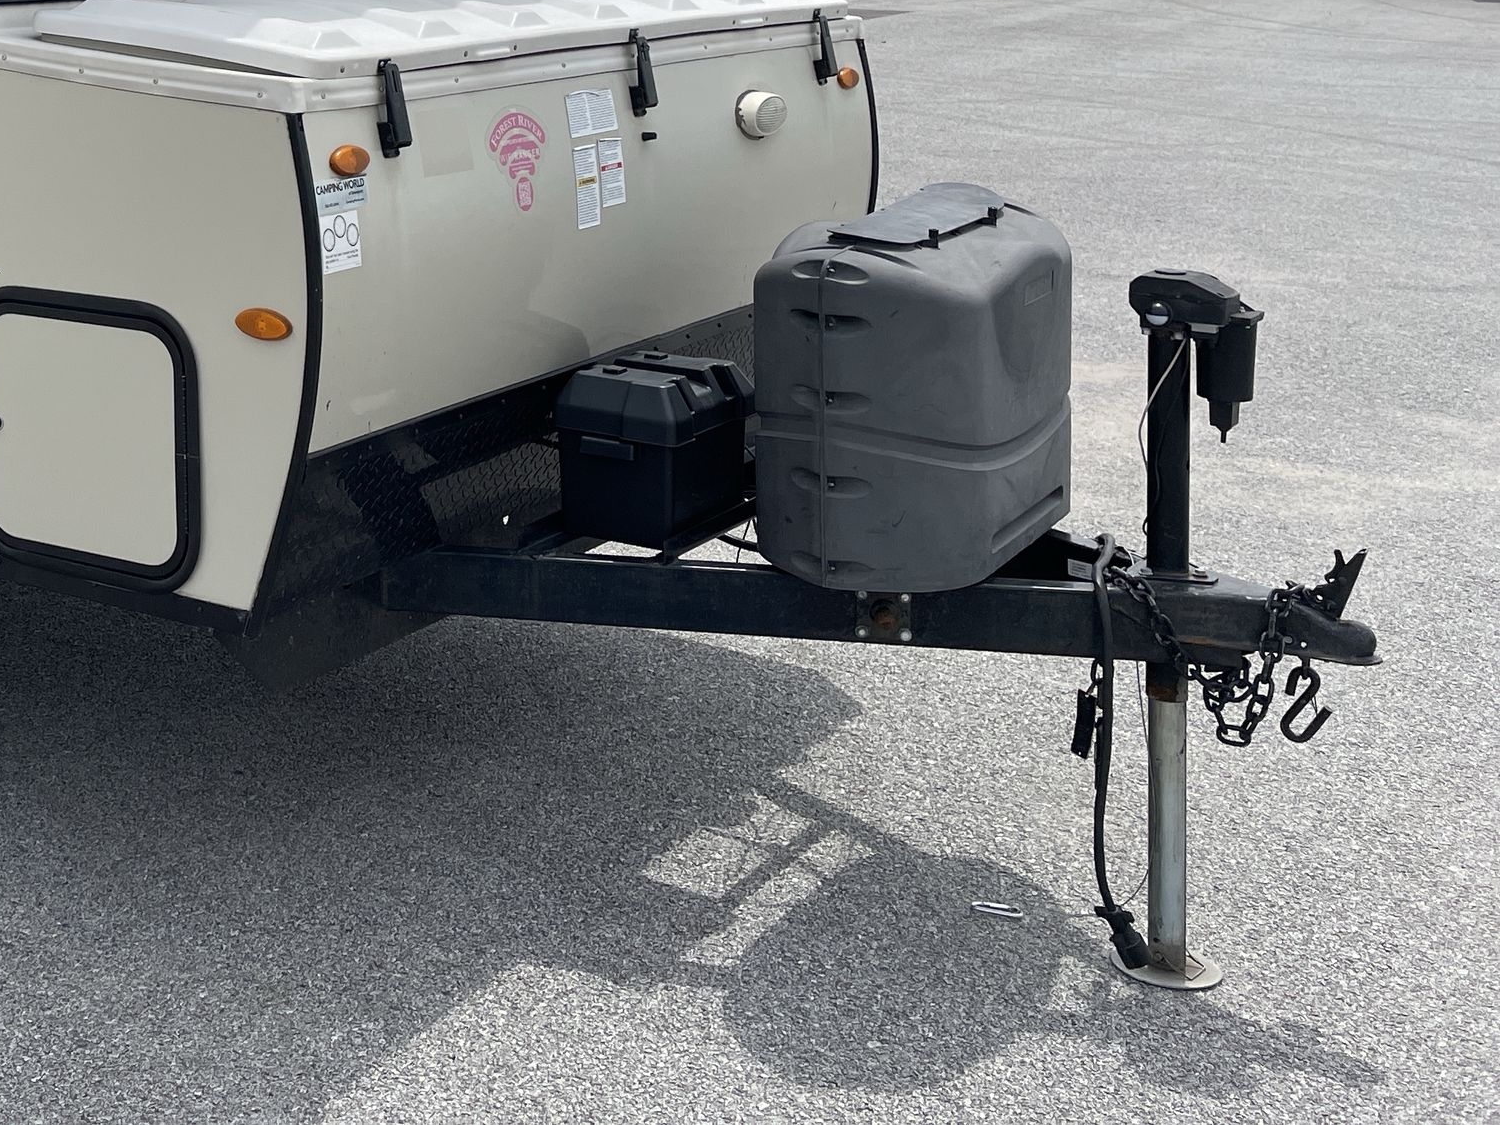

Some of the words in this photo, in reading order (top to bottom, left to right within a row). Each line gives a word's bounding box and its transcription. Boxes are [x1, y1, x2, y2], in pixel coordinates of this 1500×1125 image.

[490, 116, 518, 147] FOREST
[518, 115, 543, 140] RIVER
[316, 181, 343, 195] CAMPING
[343, 178, 365, 190] WORLD
